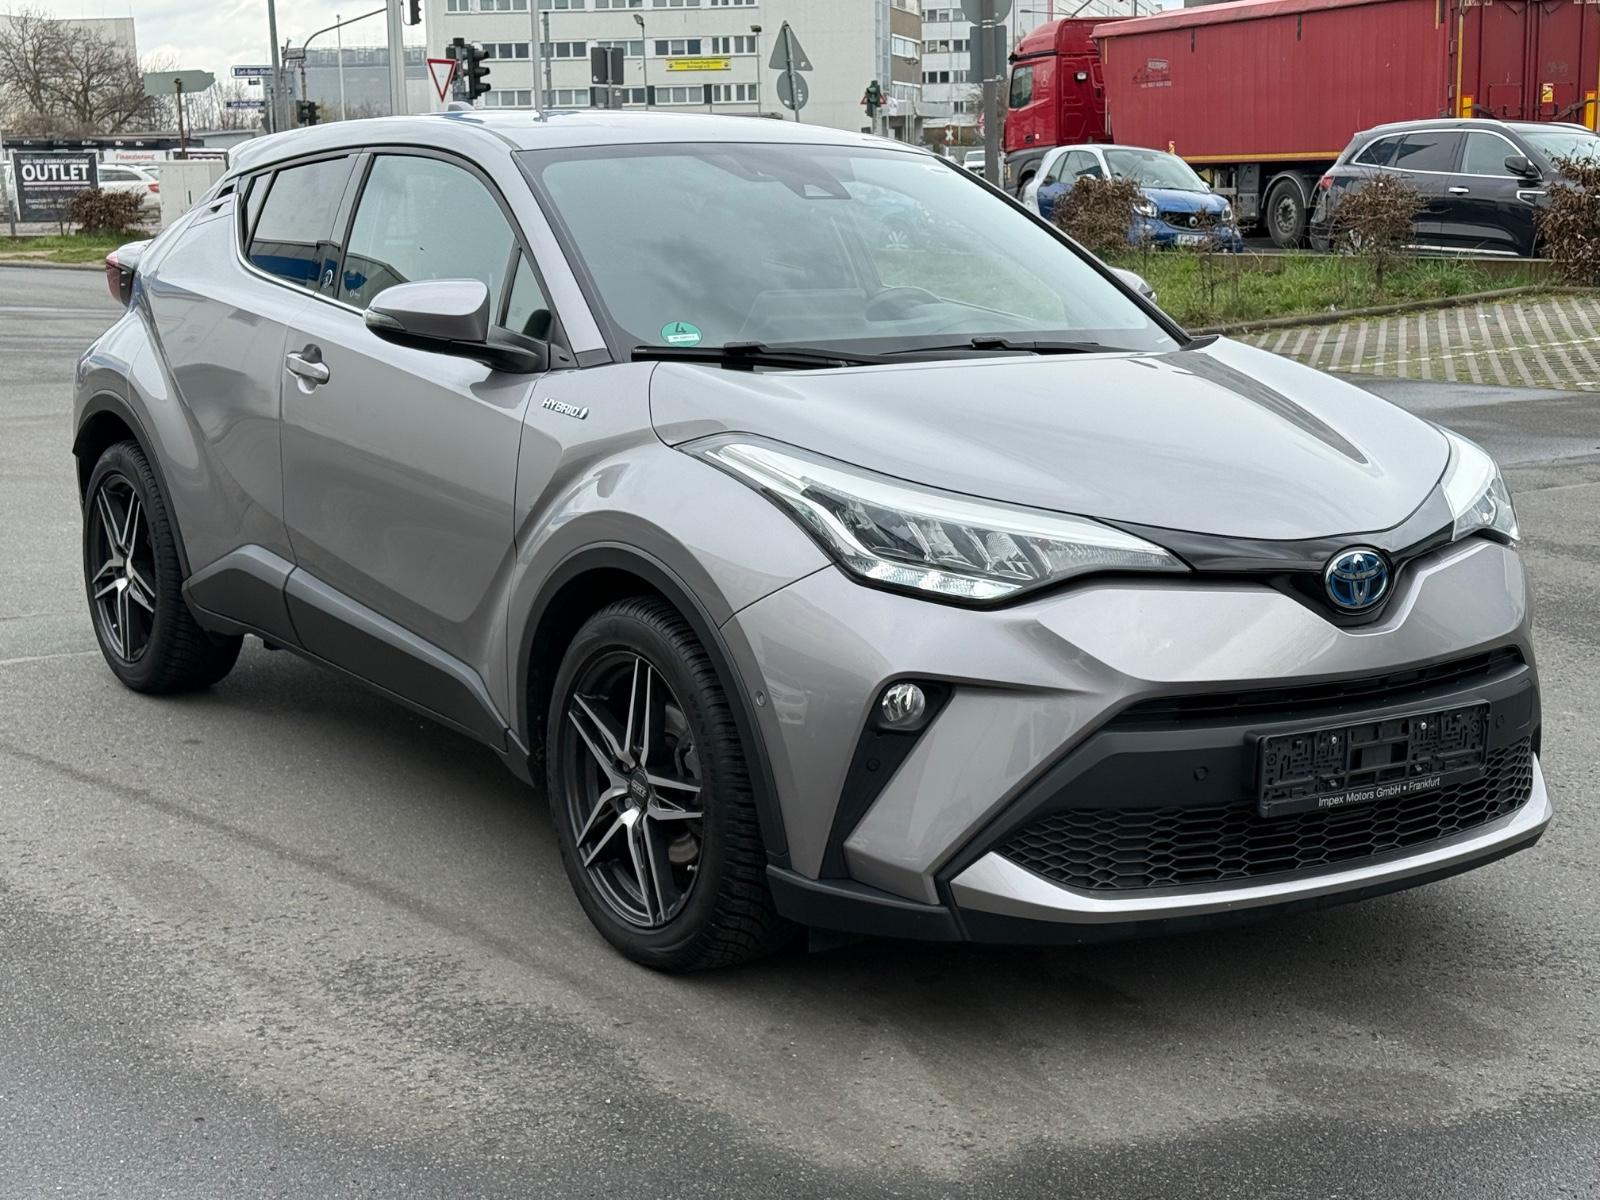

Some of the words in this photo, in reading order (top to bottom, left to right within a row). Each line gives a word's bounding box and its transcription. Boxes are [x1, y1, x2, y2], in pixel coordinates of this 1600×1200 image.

[21, 164, 90, 181] OUTLET
[675, 323, 687, 333] 4
[541, 397, 579, 418] HYBRID
[1318, 796, 1344, 808] Impex
[1346, 790, 1374, 803] Motors
[1376, 784, 1401, 798] GmbH
[1408, 777, 1440, 791] Frankfurt
